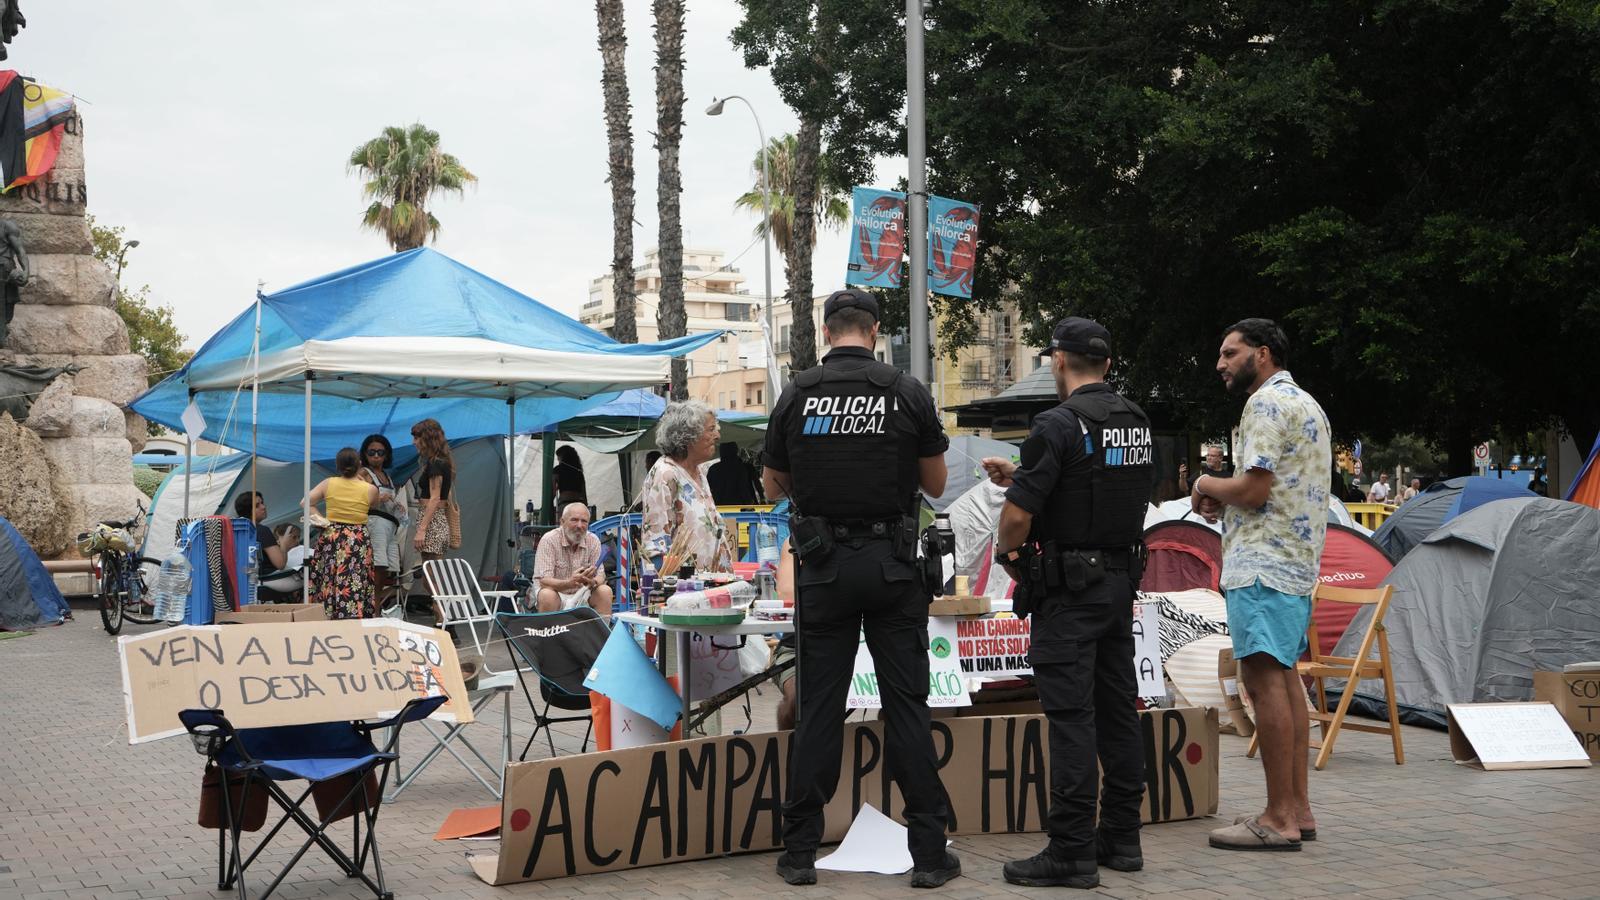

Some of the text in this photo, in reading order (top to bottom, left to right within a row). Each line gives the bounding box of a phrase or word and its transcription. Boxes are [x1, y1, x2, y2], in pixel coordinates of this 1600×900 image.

[861, 206, 904, 220] Evolution
[855, 216, 898, 231] Mallorca
[935, 214, 978, 232] Evolution
[802, 396, 886, 416] POLICIA
[831, 416, 886, 434] LOCAL
[1102, 428, 1152, 447] POLICIA
[1123, 447, 1153, 465] LOCAL
[1316, 572, 1366, 583] uechua
[524, 625, 570, 637] makita
[957, 618, 1030, 638] MARI CARMEN
[139, 633, 442, 668] VEN A LAS 18:30
[958, 636, 1031, 657] NO ESTÁS SOLA
[960, 654, 1032, 672] NI UNA MÁS
[199, 679, 222, 711] O
[239, 672, 326, 705] DEJA
[327, 672, 367, 694] TU
[522, 731, 798, 878] ACAMPA
